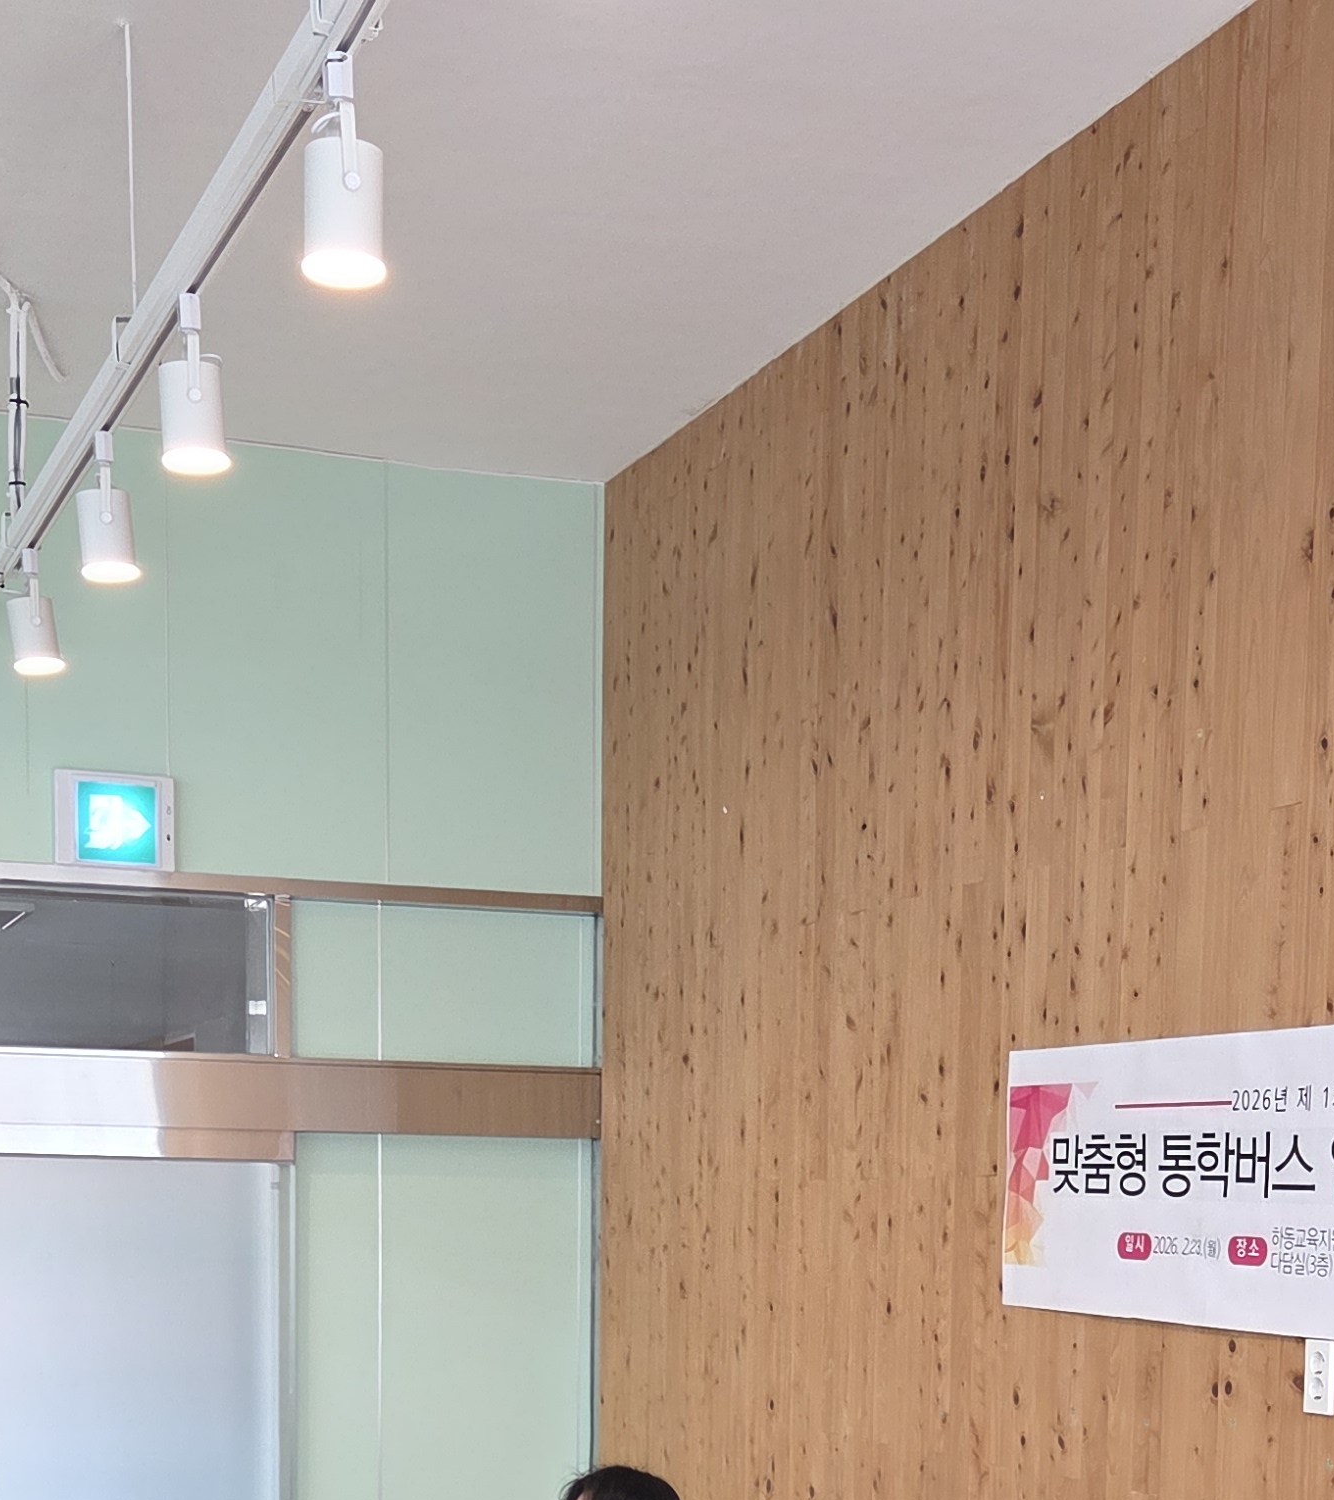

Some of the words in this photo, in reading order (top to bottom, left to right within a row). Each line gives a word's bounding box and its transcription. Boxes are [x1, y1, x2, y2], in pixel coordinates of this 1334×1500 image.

[1232, 1086, 1288, 1113] 2026년
[1297, 1084, 1312, 1112] 제
[1052, 1133, 1147, 1197] 맞춤형
[1158, 1131, 1316, 1199] 통학버스
[1124, 1234, 1146, 1253] 일시
[1235, 1238, 1260, 1258] 장소
[1270, 1252, 1334, 1279] 다담실(3층)
